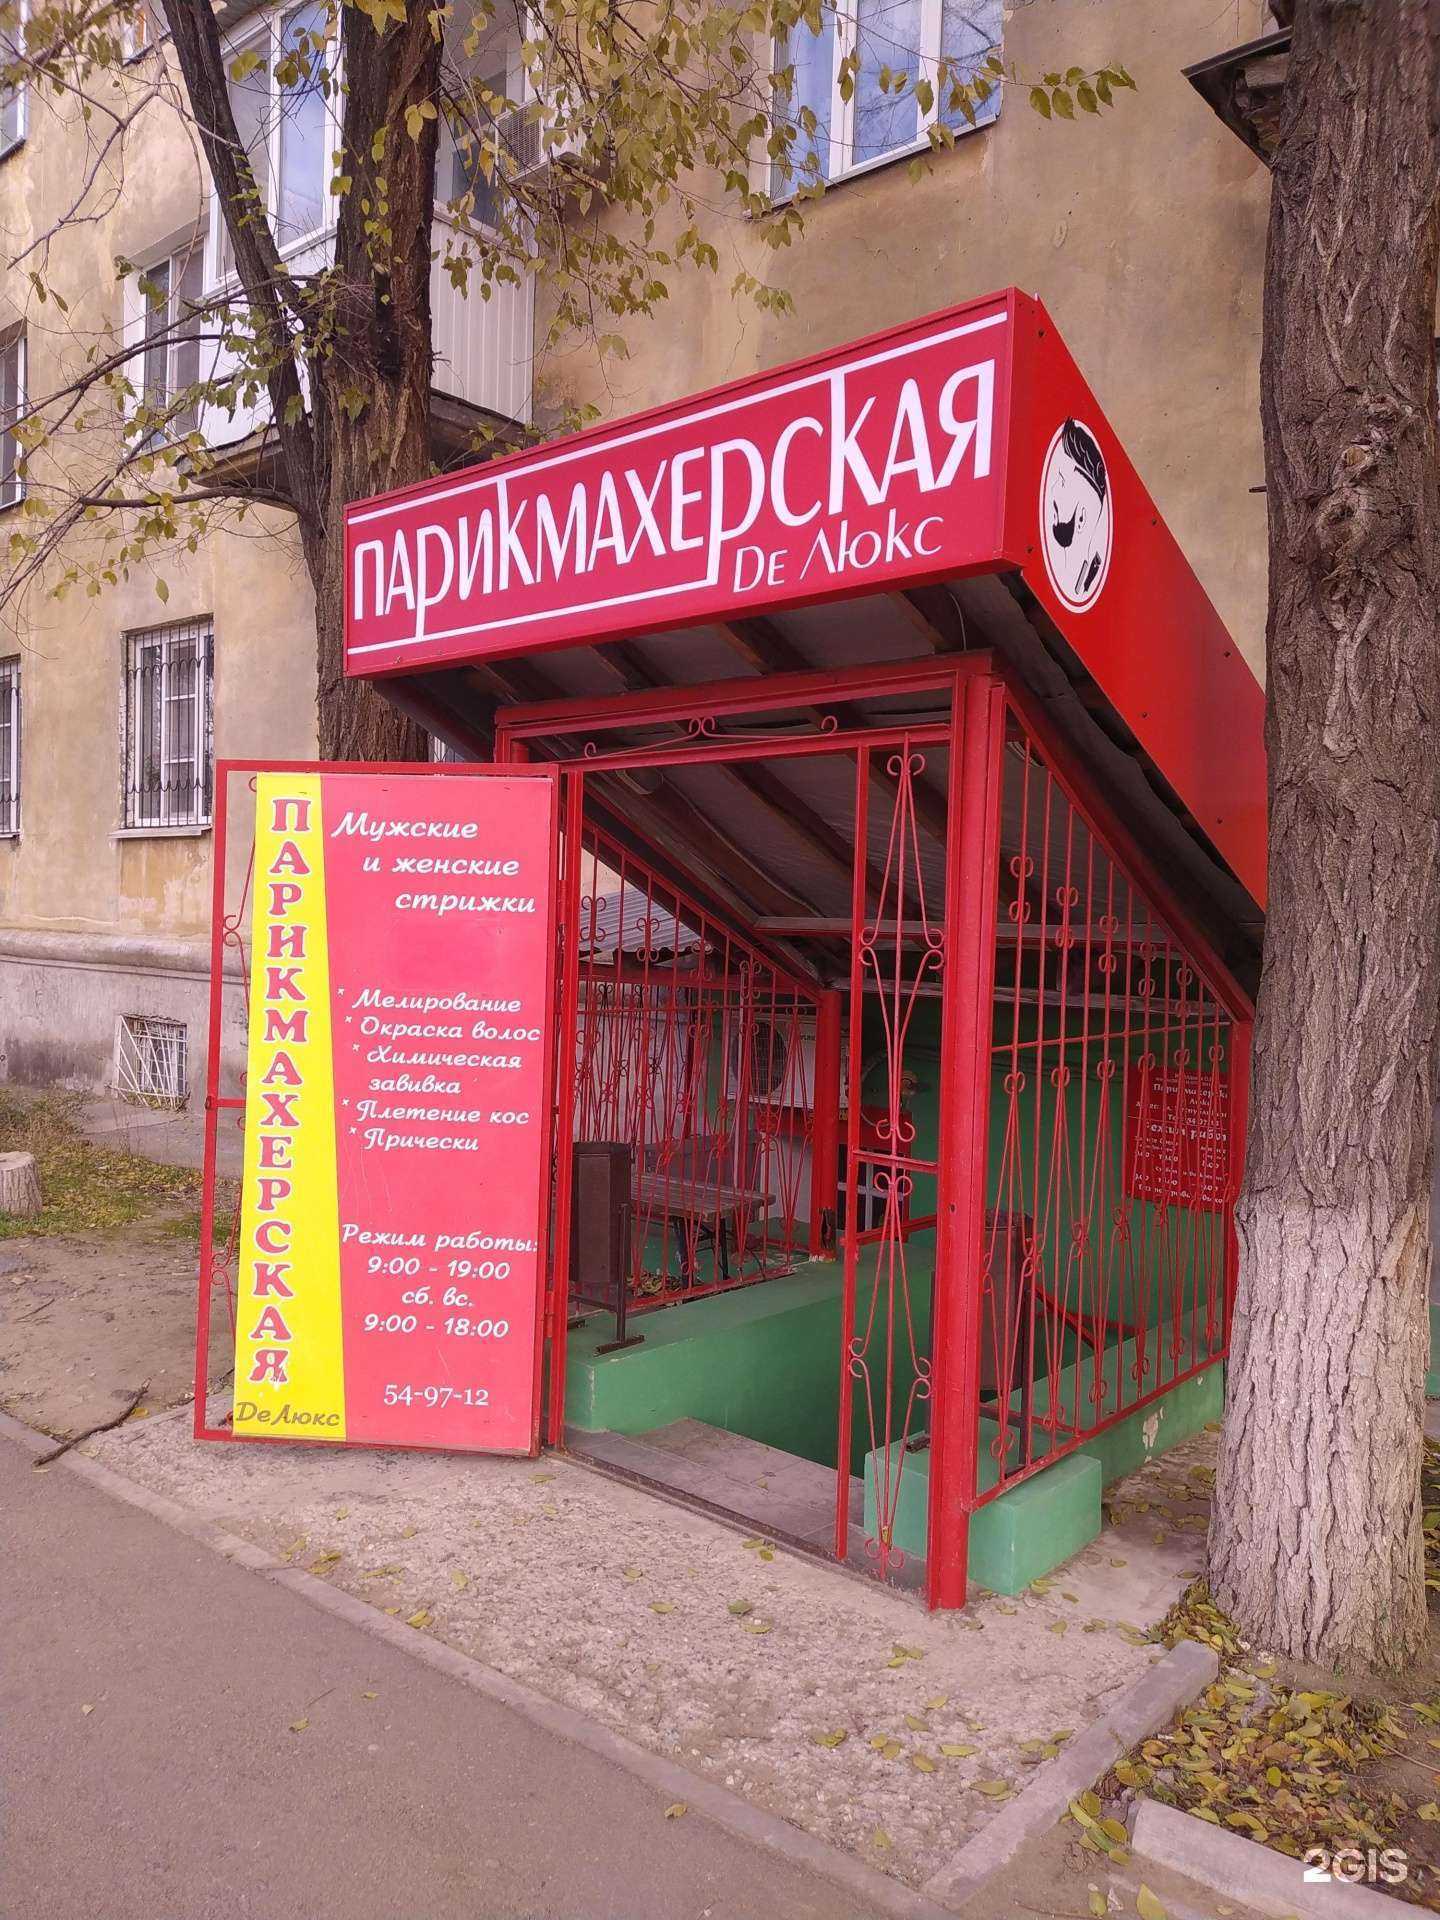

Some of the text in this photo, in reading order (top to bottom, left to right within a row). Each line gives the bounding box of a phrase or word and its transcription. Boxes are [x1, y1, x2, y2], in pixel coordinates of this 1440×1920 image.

[354, 358, 995, 640] ПАРИКМАХЕРСКАЯ
[331, 812, 479, 842] Мужские
[362, 857, 520, 876] и женские
[395, 893, 536, 915] стрижки
[352, 989, 521, 1013] Мелирование
[360, 1016, 541, 1041] Окраска волос
[366, 1045, 523, 1069] Химическая
[249, 798, 312, 1385] ПАРИКМАХЕРСКАЯ
[368, 1074, 461, 1094] завивка
[356, 1100, 530, 1125] Плетение кос
[364, 1128, 479, 1151] Прически
[341, 1223, 426, 1247] Режим
[367, 1256, 420, 1275] 9:00
[447, 1260, 511, 1280] 19:00
[401, 1286, 474, 1308] сб. вс.
[364, 1313, 417, 1333] 9:00
[444, 1317, 509, 1338] 18:00
[383, 1385, 489, 1407] 54-97-12
